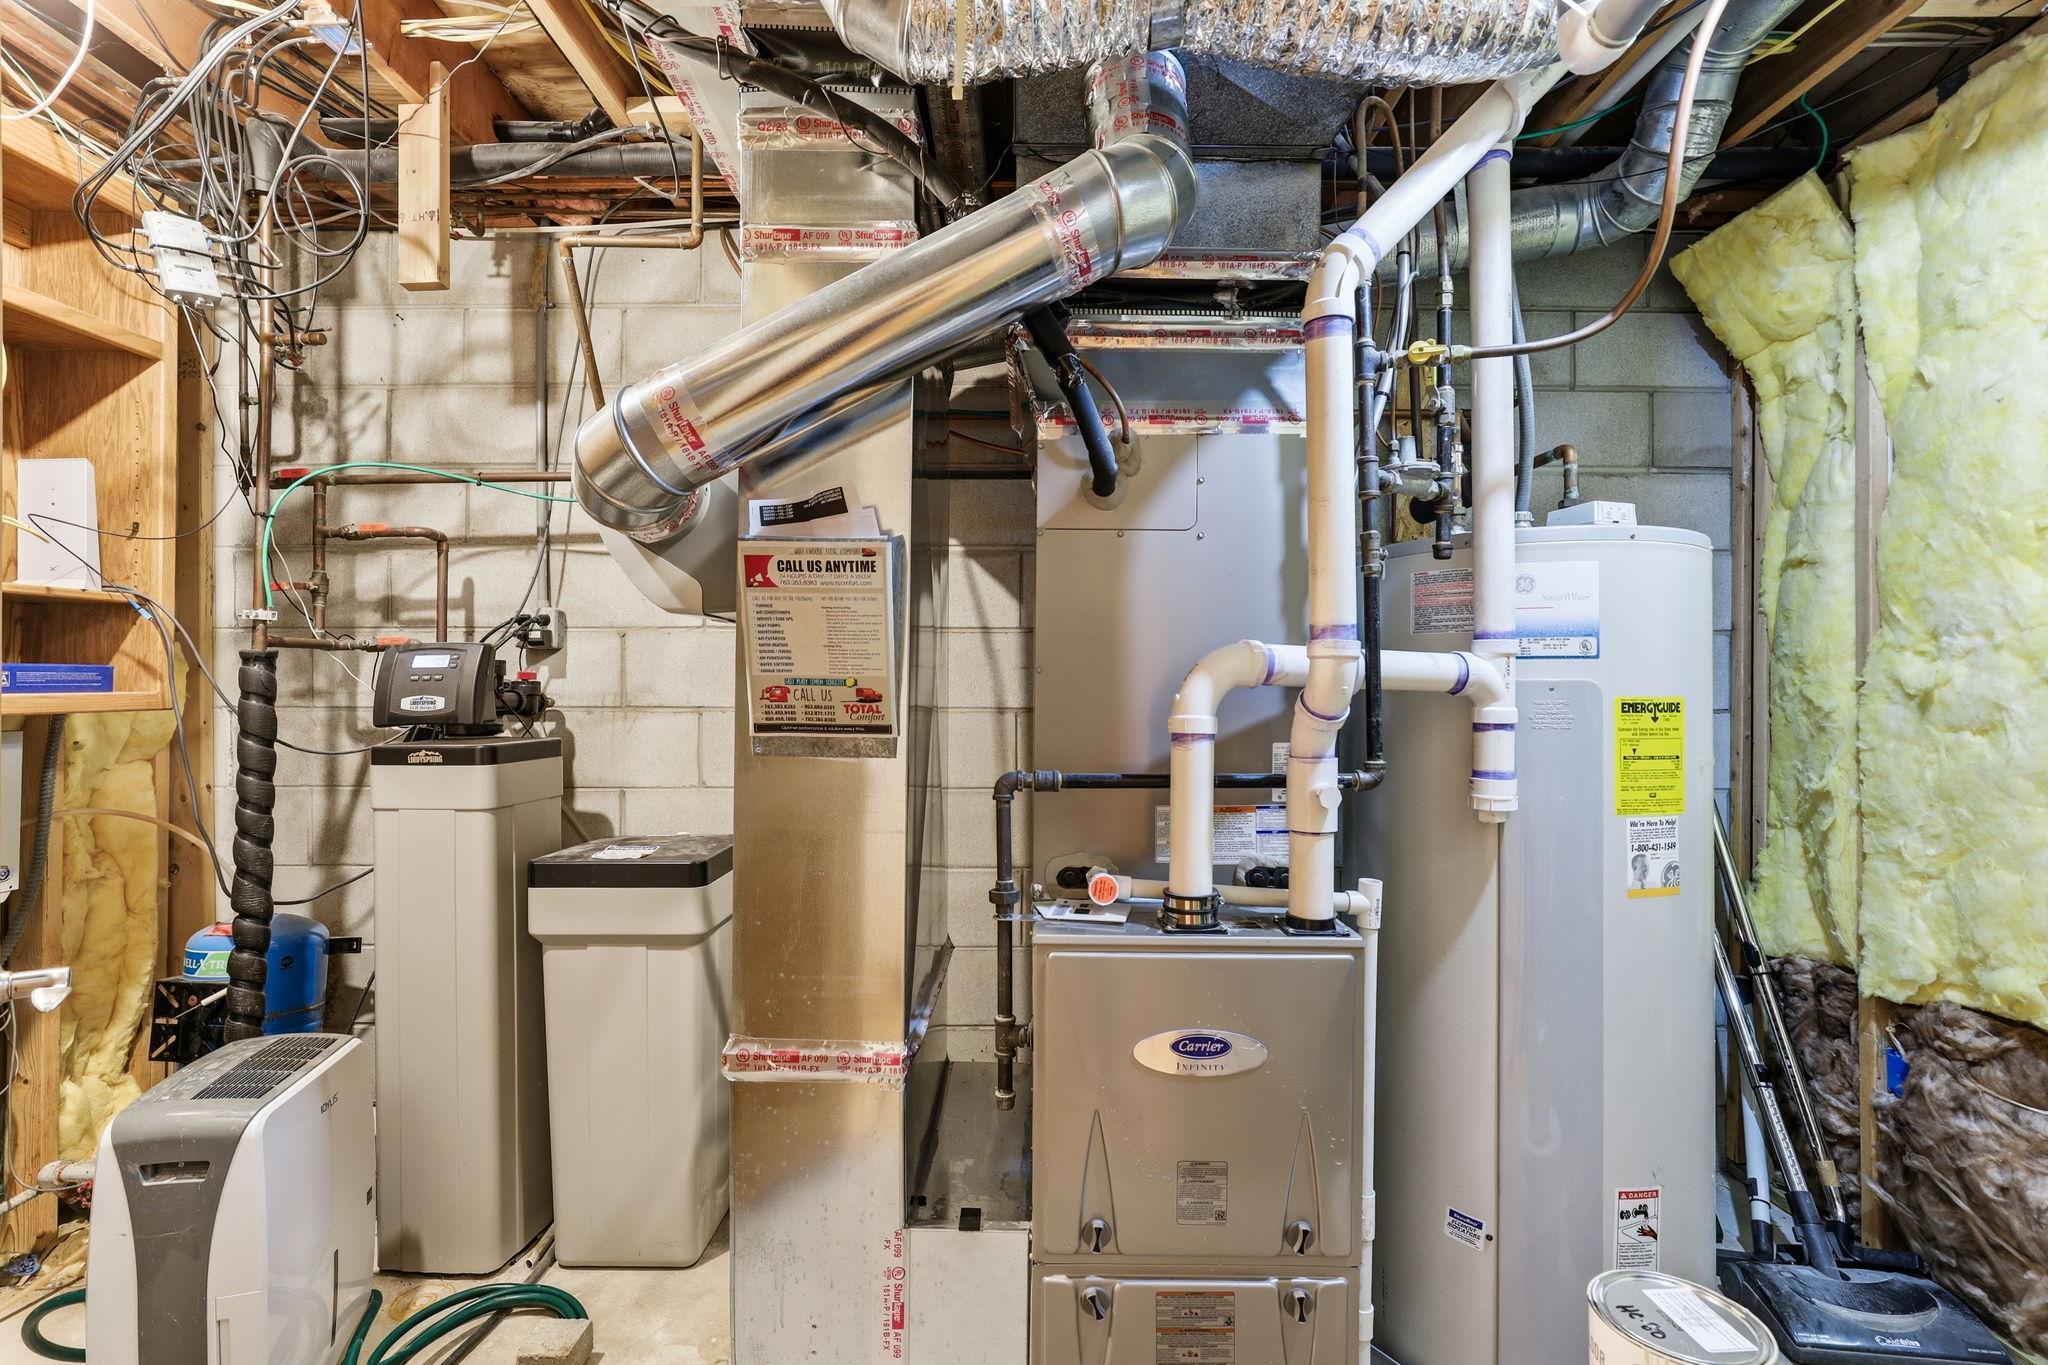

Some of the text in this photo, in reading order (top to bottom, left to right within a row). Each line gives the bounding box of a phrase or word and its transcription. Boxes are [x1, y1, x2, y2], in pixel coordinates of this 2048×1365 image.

[754, 230, 830, 241] Shurtape AF 099
[856, 230, 914, 240] Shurtape AF
[669, 401, 697, 442] Shurtape
[776, 560, 877, 573] CALL US ANYTIME
[793, 688, 833, 702] CALL US
[844, 704, 882, 714] TOTAL
[850, 713, 886, 723] Comfort
[1630, 820, 1645, 828] We're
[1178, 1040, 1224, 1052] Carrier
[753, 1053, 829, 1063] Shurtape AF 099
[854, 1055, 892, 1066] Shurtape
[1176, 1062, 1225, 1071] INFINITY
[1628, 1191, 1657, 1199] DANGER
[894, 1231, 902, 1258] AF 099
[893, 1283, 903, 1324] Shurtape
[894, 1331, 902, 1343] AF
